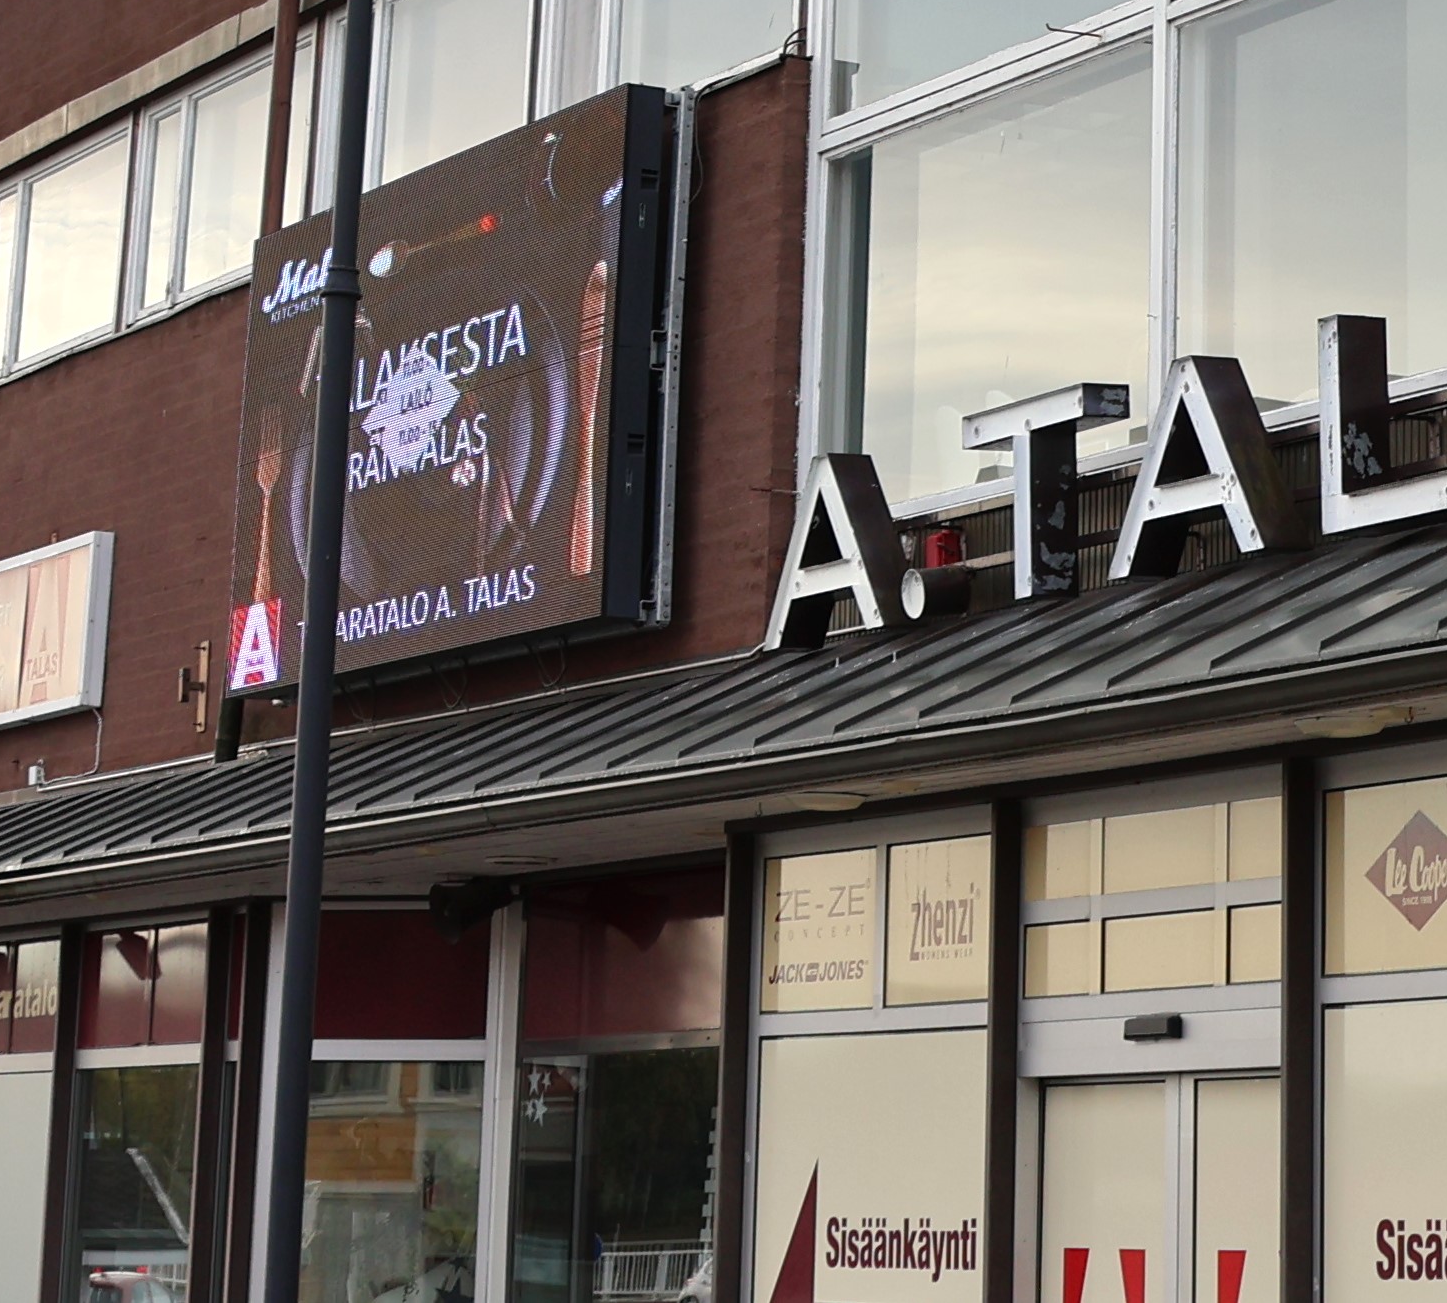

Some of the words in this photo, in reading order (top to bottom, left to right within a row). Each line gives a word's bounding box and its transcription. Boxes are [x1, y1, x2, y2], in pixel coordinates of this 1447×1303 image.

[415, 412, 489, 472] ALAS
[464, 564, 536, 614] TALAS
[24, 651, 59, 683] TALAS
[1385, 847, 1409, 897] Lee
[768, 963, 805, 985] JACK
[818, 959, 866, 982] JONES
[825, 1216, 977, 1282] Sisäänkäynti
